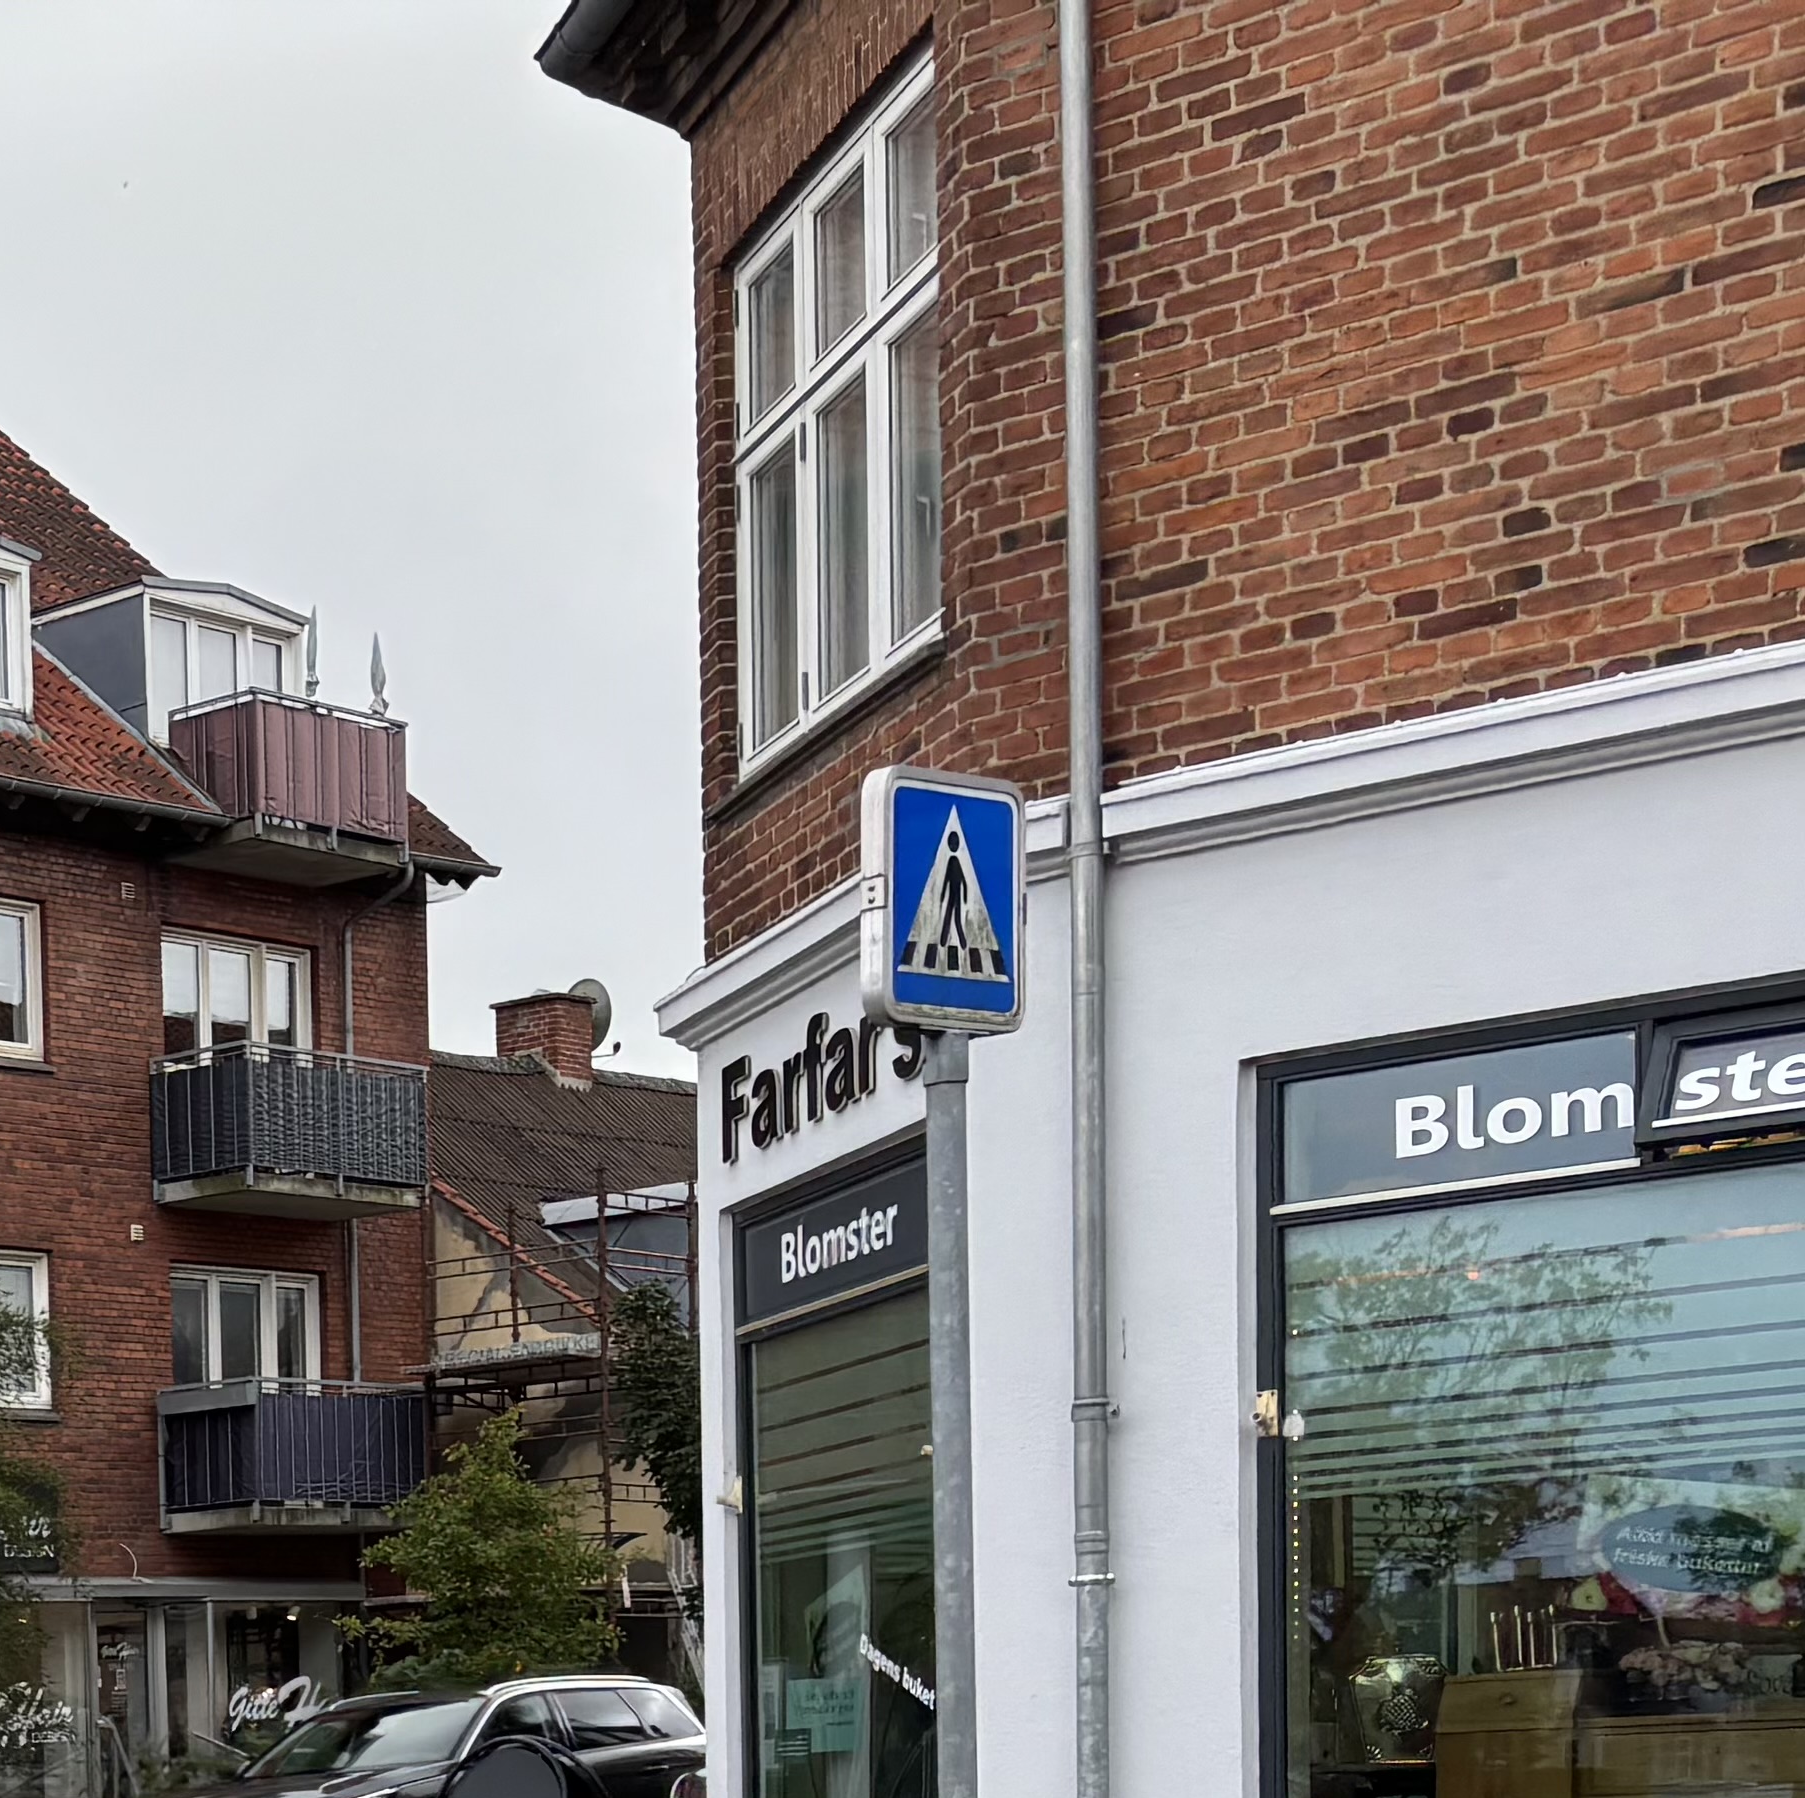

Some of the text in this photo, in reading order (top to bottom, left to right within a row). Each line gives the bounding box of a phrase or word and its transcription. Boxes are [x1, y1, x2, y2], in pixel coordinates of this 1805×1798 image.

[780, 1203, 899, 1284] Blomster
[228, 1685, 280, 1732] Gitte
[859, 1632, 902, 1683] Dagens
[901, 1666, 936, 1711] buket
